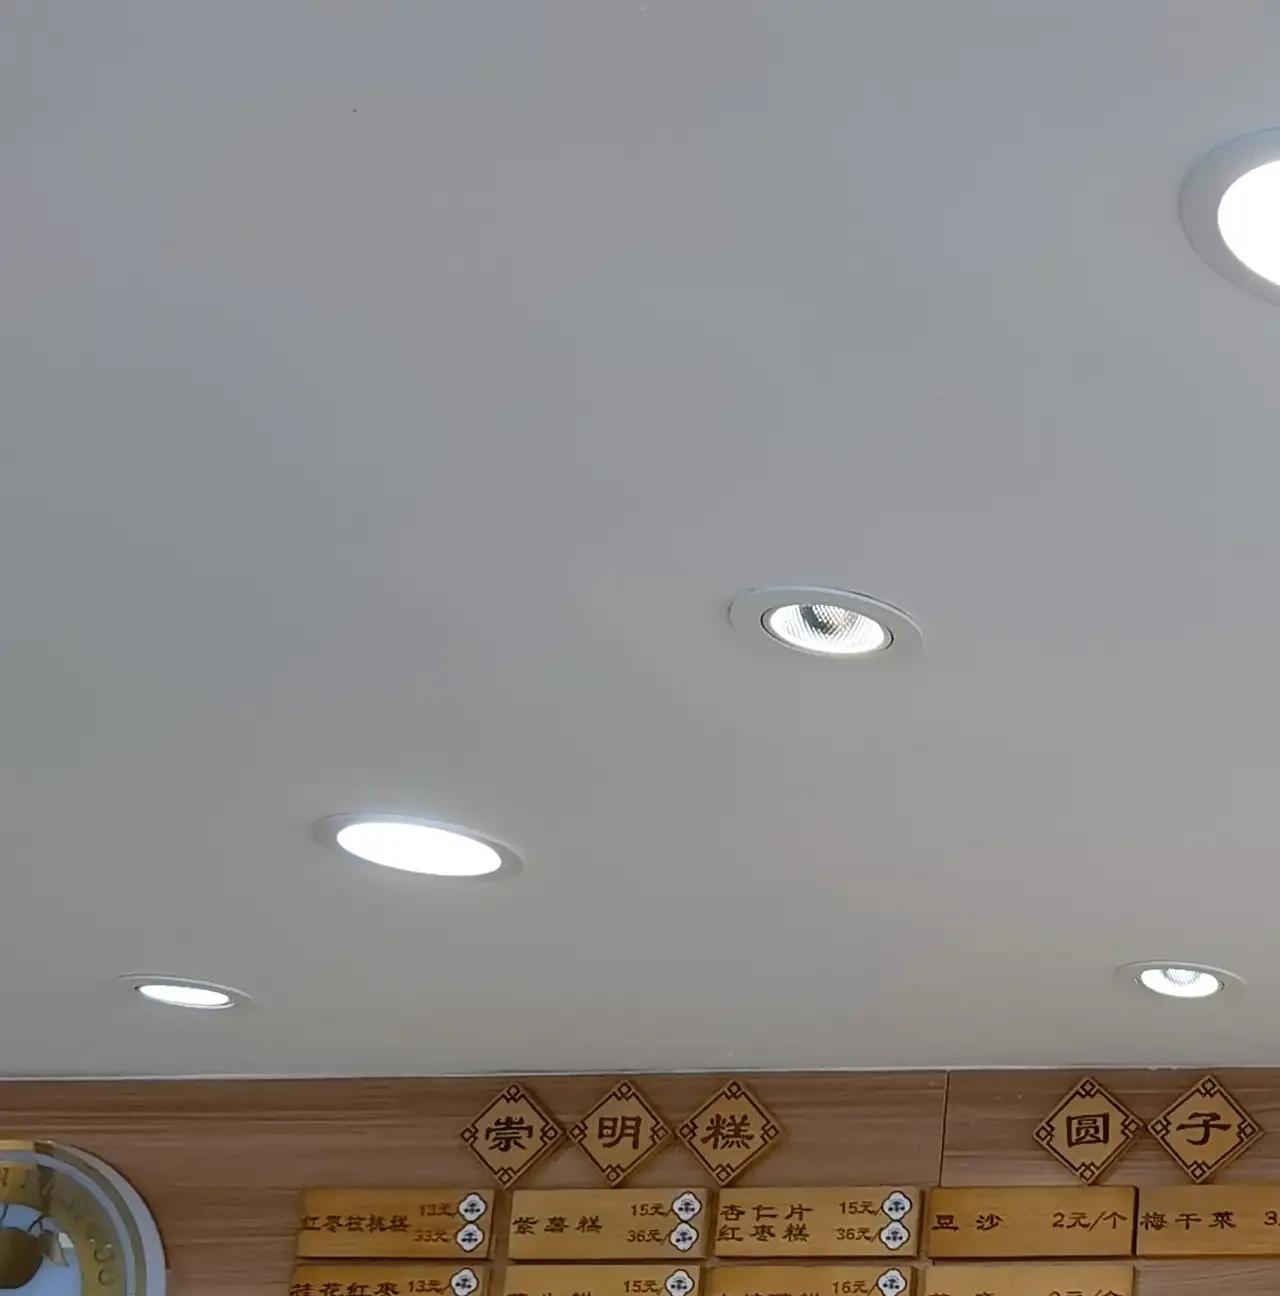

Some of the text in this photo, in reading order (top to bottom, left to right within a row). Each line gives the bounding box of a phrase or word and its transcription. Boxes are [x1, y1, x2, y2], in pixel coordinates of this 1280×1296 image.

[483, 1112, 755, 1152] 崇明糕
[1066, 1112, 1232, 1146] 圆子
[720, 1204, 813, 1221] 杏仁片
[932, 1212, 1127, 1230] 豆沙 2元/个
[1140, 1211, 1236, 1230] 梅干菜
[302, 1216, 410, 1232] 红枣核桃糕
[513, 1216, 603, 1235] 紫薯糕
[717, 1224, 810, 1242] 红枣糕
